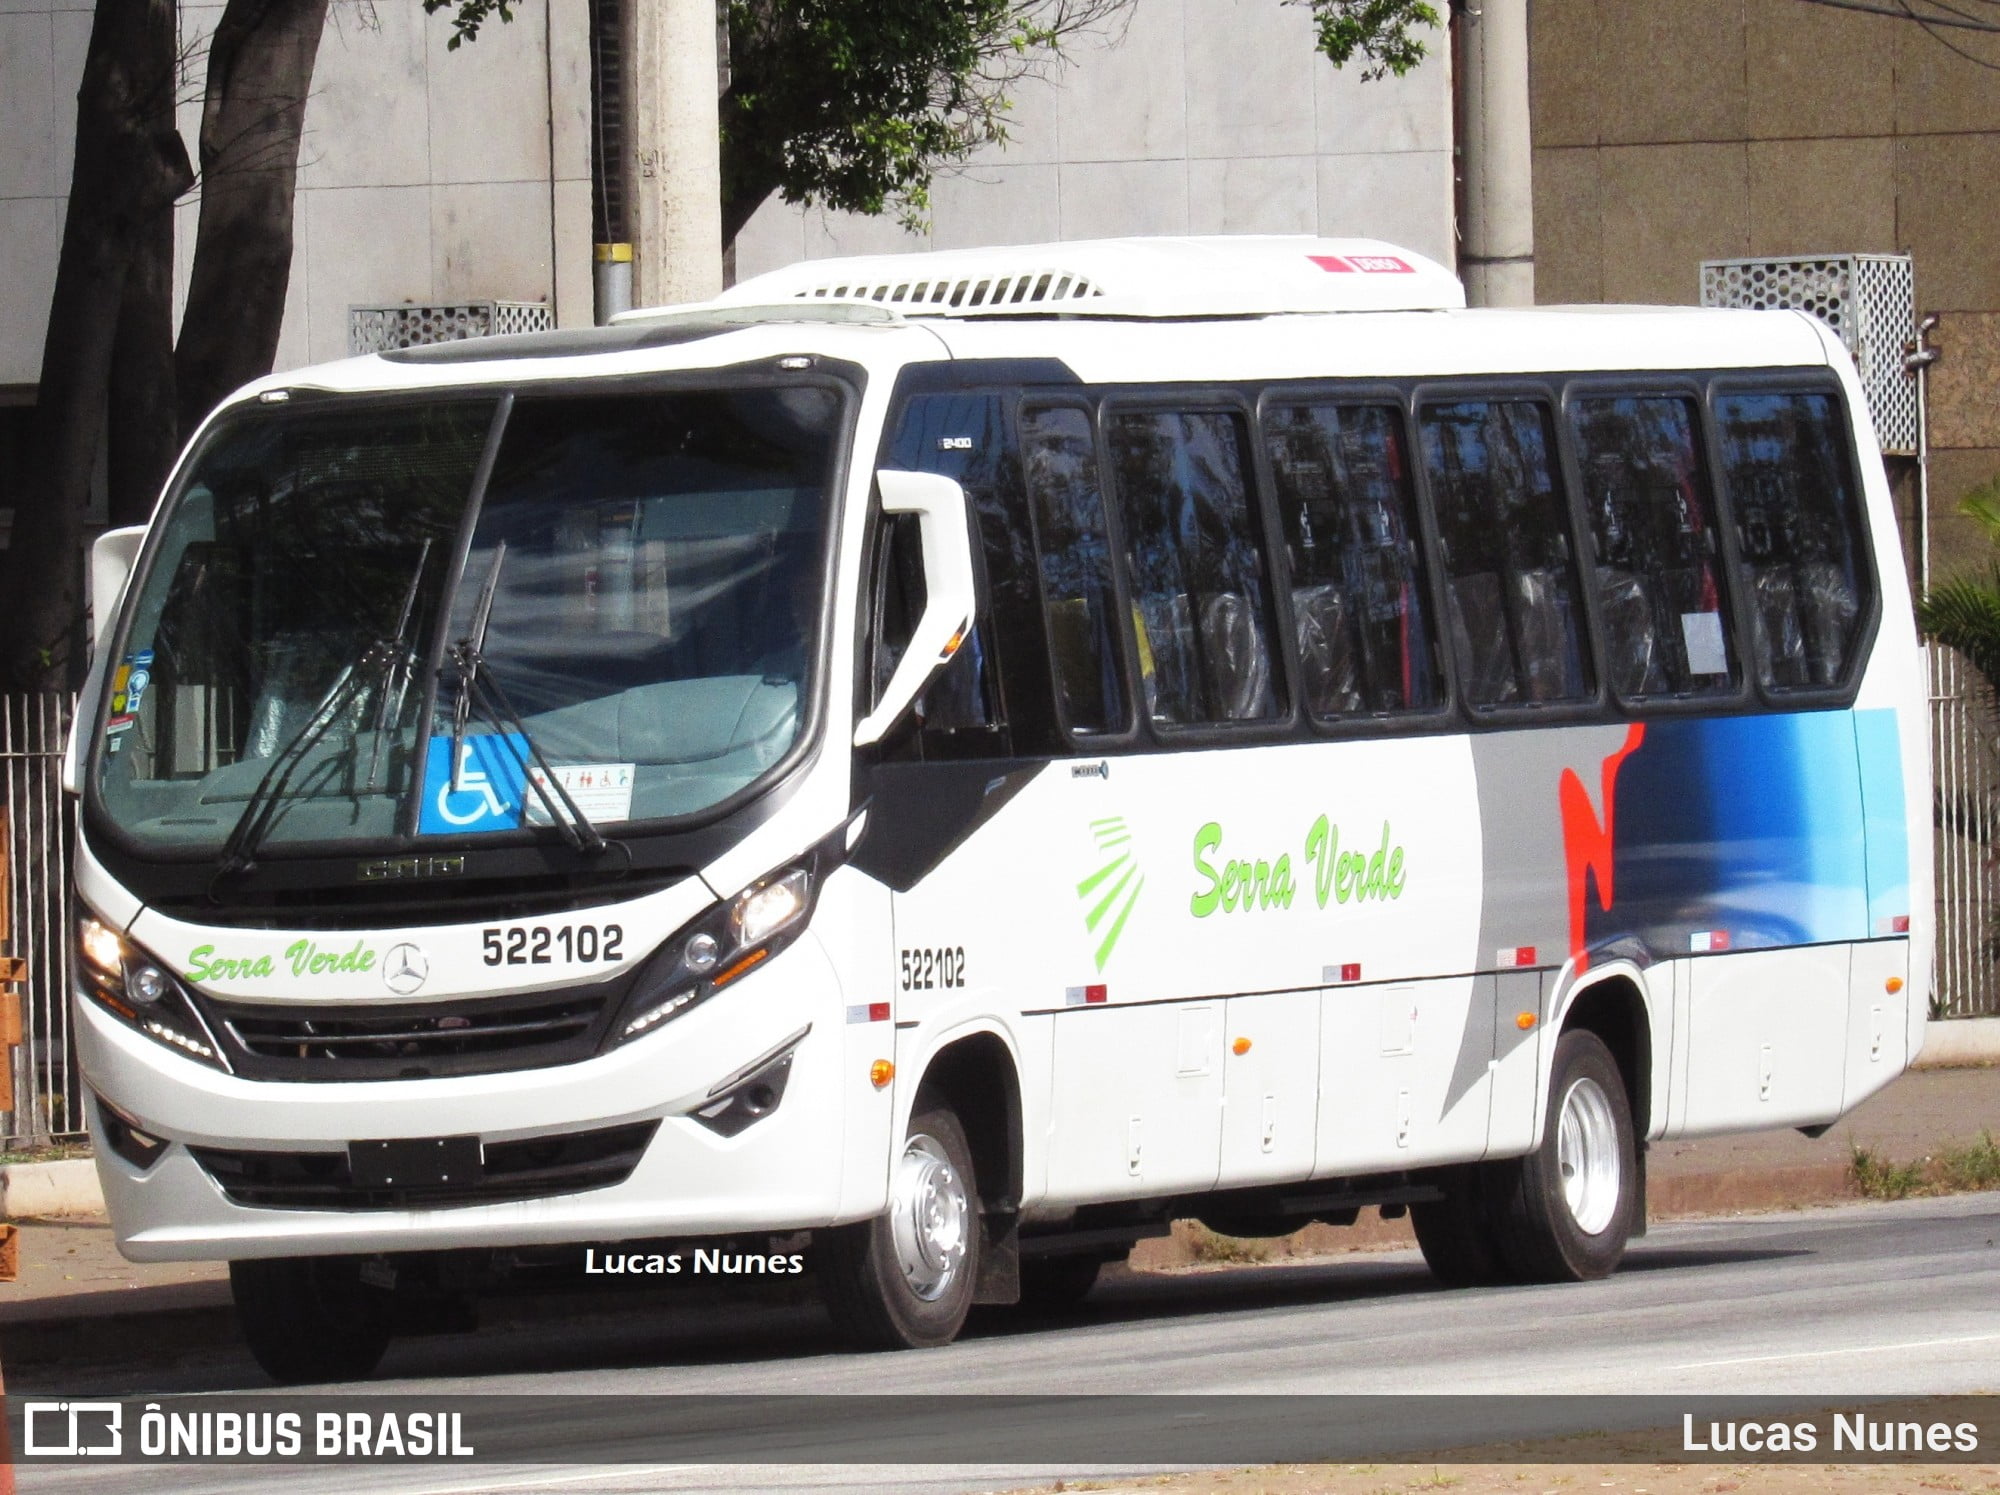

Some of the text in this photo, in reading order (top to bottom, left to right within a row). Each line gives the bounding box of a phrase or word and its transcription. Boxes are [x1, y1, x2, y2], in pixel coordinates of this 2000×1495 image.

[1190, 813, 1407, 919] Serra Verde
[186, 938, 377, 984] Serra Verde
[483, 924, 623, 967] 522102
[902, 946, 965, 991] 522102
